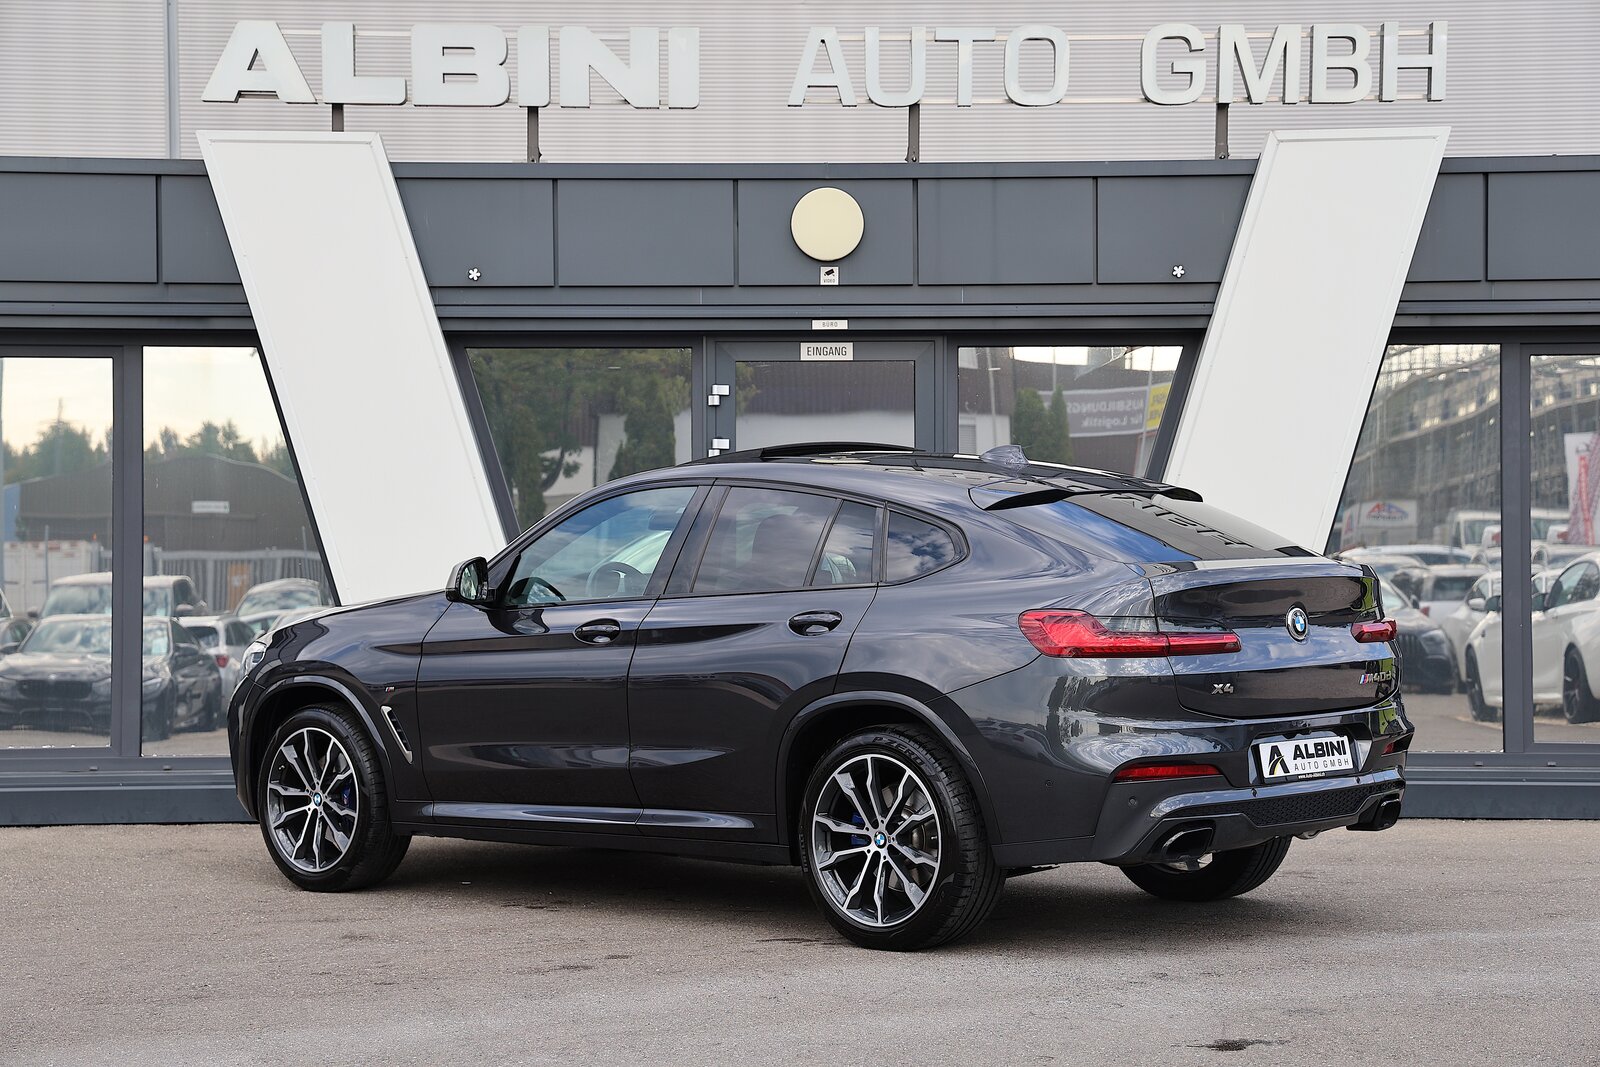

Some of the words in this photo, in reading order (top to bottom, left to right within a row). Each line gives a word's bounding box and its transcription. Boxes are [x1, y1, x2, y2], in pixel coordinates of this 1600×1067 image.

[201, 21, 700, 109] ALBINI
[788, 24, 1070, 107] AUTO
[1140, 20, 1448, 105] GMBH
[806, 346, 847, 356] EINGANG
[1211, 683, 1234, 695] X4
[1293, 740, 1347, 761] ALBINI
[1294, 760, 1319, 772] AUTO
[1320, 758, 1350, 769] GMBH
